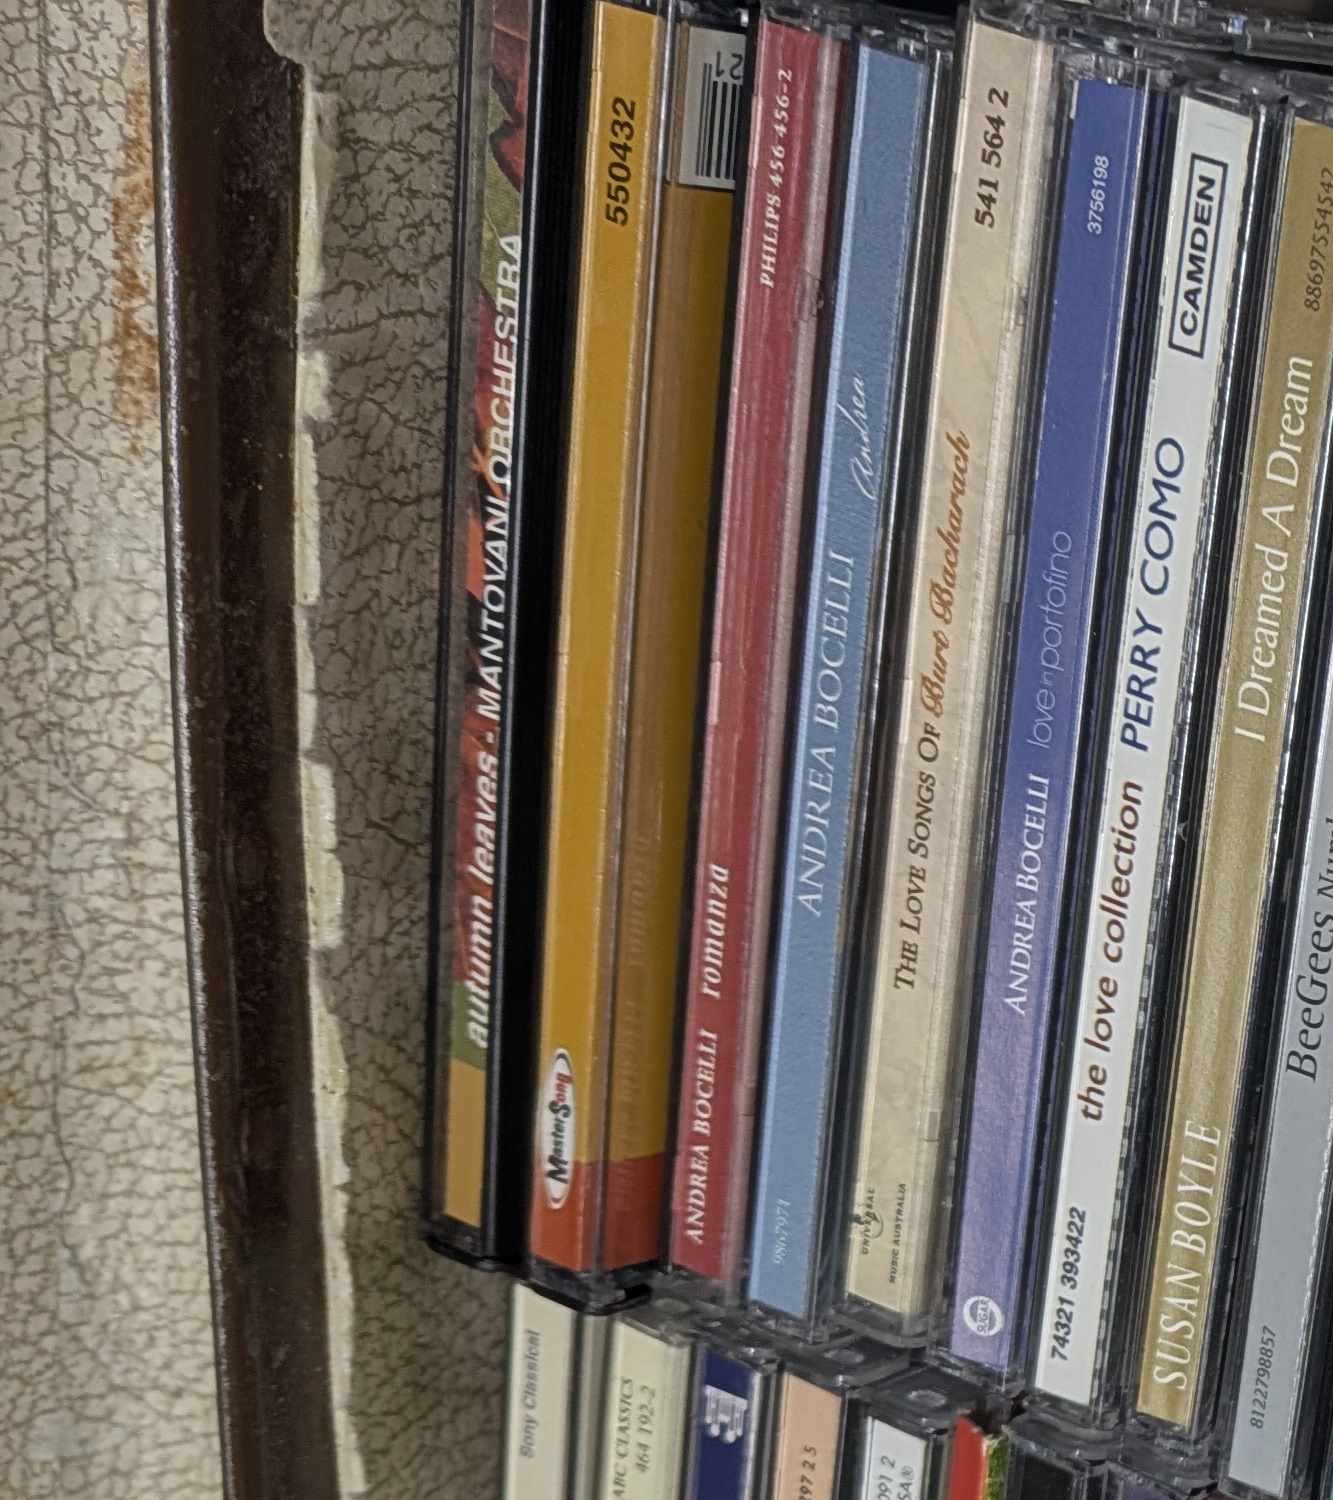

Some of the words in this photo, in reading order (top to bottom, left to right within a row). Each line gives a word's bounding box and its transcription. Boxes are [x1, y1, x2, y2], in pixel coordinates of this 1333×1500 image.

[605, 97, 635, 225] 550432
[981, 115, 1005, 167] 564
[1087, 155, 1108, 233] 3756198
[760, 194, 783, 286] PHILIPS
[974, 178, 998, 227] 541
[1180, 175, 1214, 335] CAMDEN
[486, 236, 521, 488] ORCHESTRA
[929, 431, 969, 624] Bacharach
[1139, 437, 1183, 595] COMO
[1238, 543, 1287, 714] Dreamed
[1266, 357, 1312, 486] Dream
[478, 499, 509, 720] MANTOVANI
[814, 551, 853, 727] BOCELLI
[1040, 531, 1071, 671] portofino
[1026, 688, 1055, 748] love
[1120, 609, 1161, 750] PERRY
[797, 747, 835, 915] ANDREA
[1015, 774, 1048, 891] BOCELLI
[1101, 781, 1141, 962] collection
[702, 864, 728, 996] romanza
[1004, 900, 1036, 1015] ANDREA
[1083, 976, 1118, 1051] love
[545, 1073, 573, 1183] MasterSong
[693, 1029, 716, 1134] BOCELLI
[1077, 1064, 1107, 1120] the
[686, 1145, 708, 1242] ANDREA
[1170, 1120, 1220, 1253] BOYLE
[1060, 1205, 1086, 1288] 393422
[1050, 1296, 1073, 1359] 74321
[1153, 1263, 1199, 1389] SUSAN
[614, 1378, 632, 1458] CLASSICS
[610, 1464, 629, 1499] ABC
